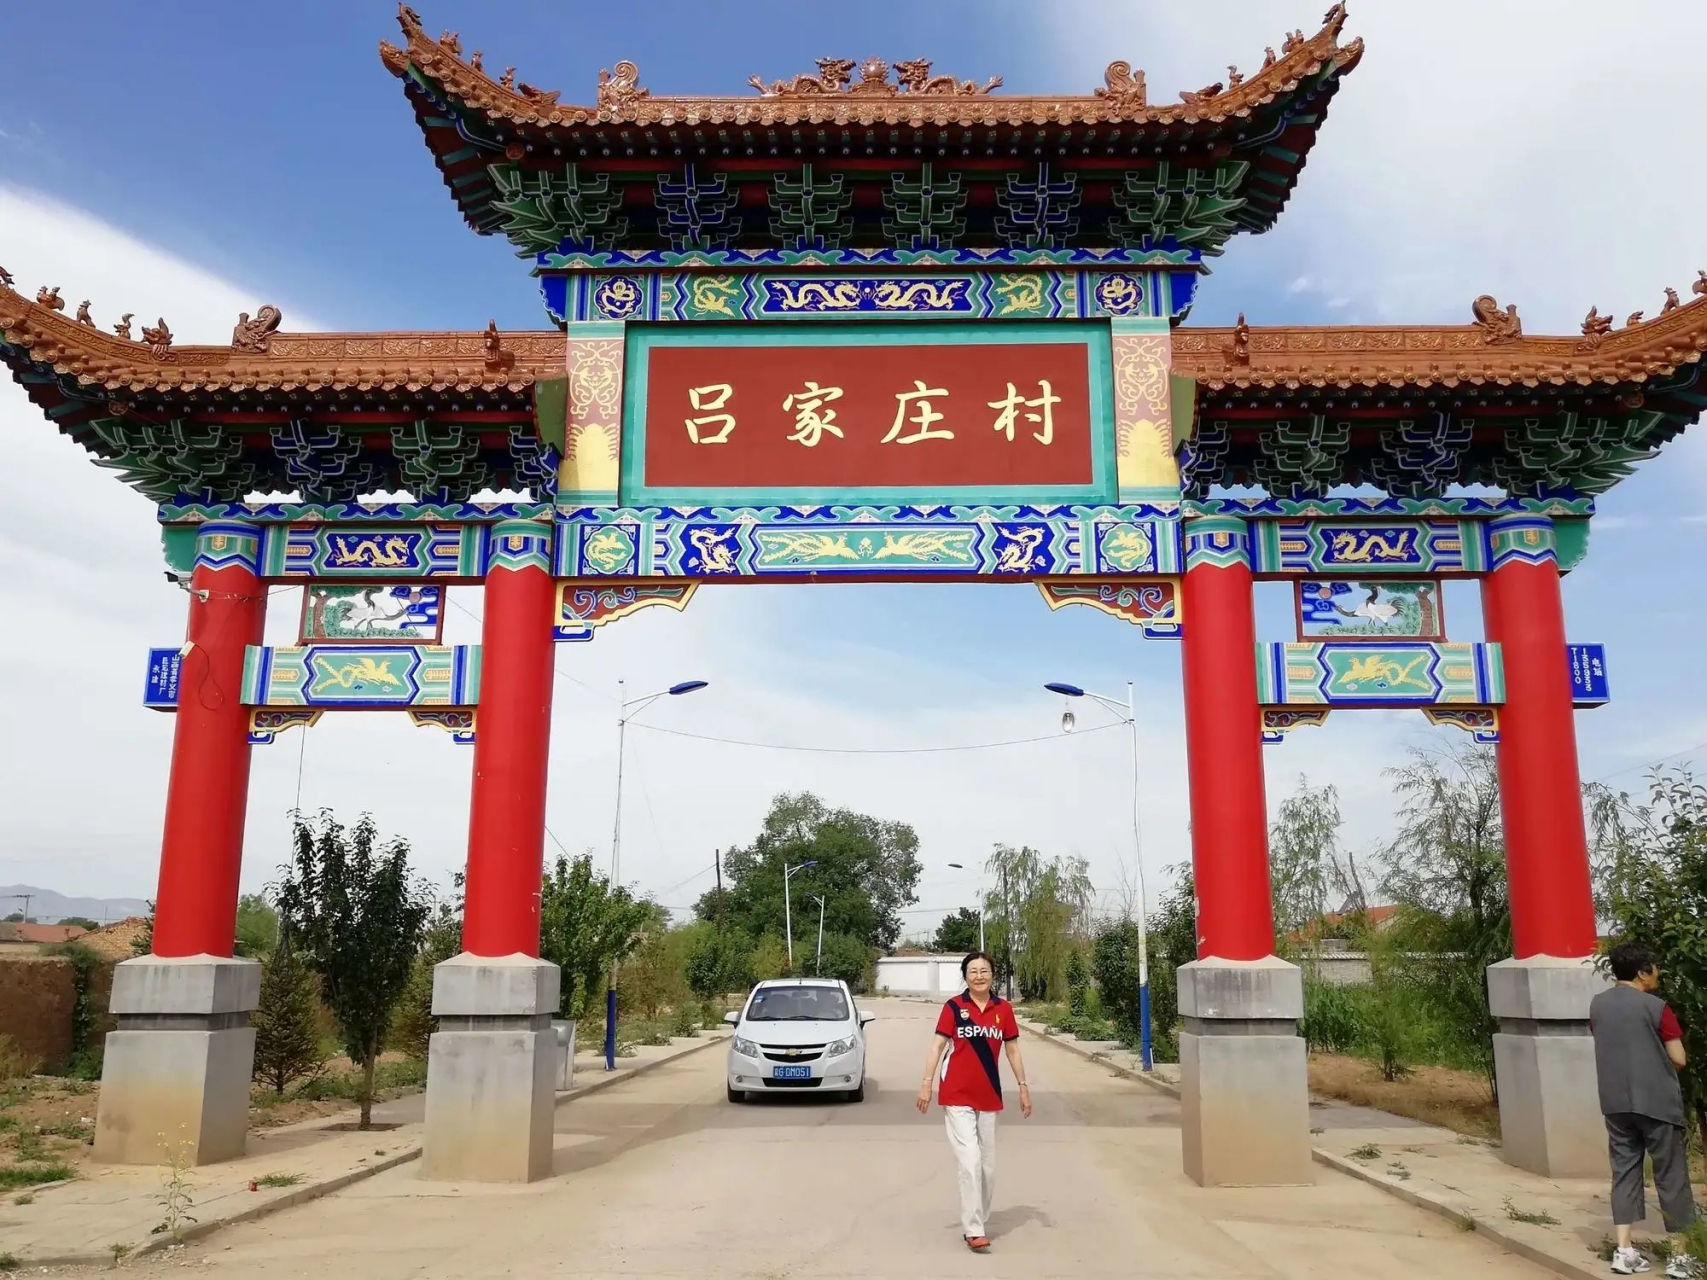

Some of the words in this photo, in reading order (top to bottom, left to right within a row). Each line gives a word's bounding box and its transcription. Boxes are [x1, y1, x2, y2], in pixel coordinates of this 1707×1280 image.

[685, 379, 1061, 447] 吕家庄村
[957, 1025, 1003, 1041] ESPAÑA
